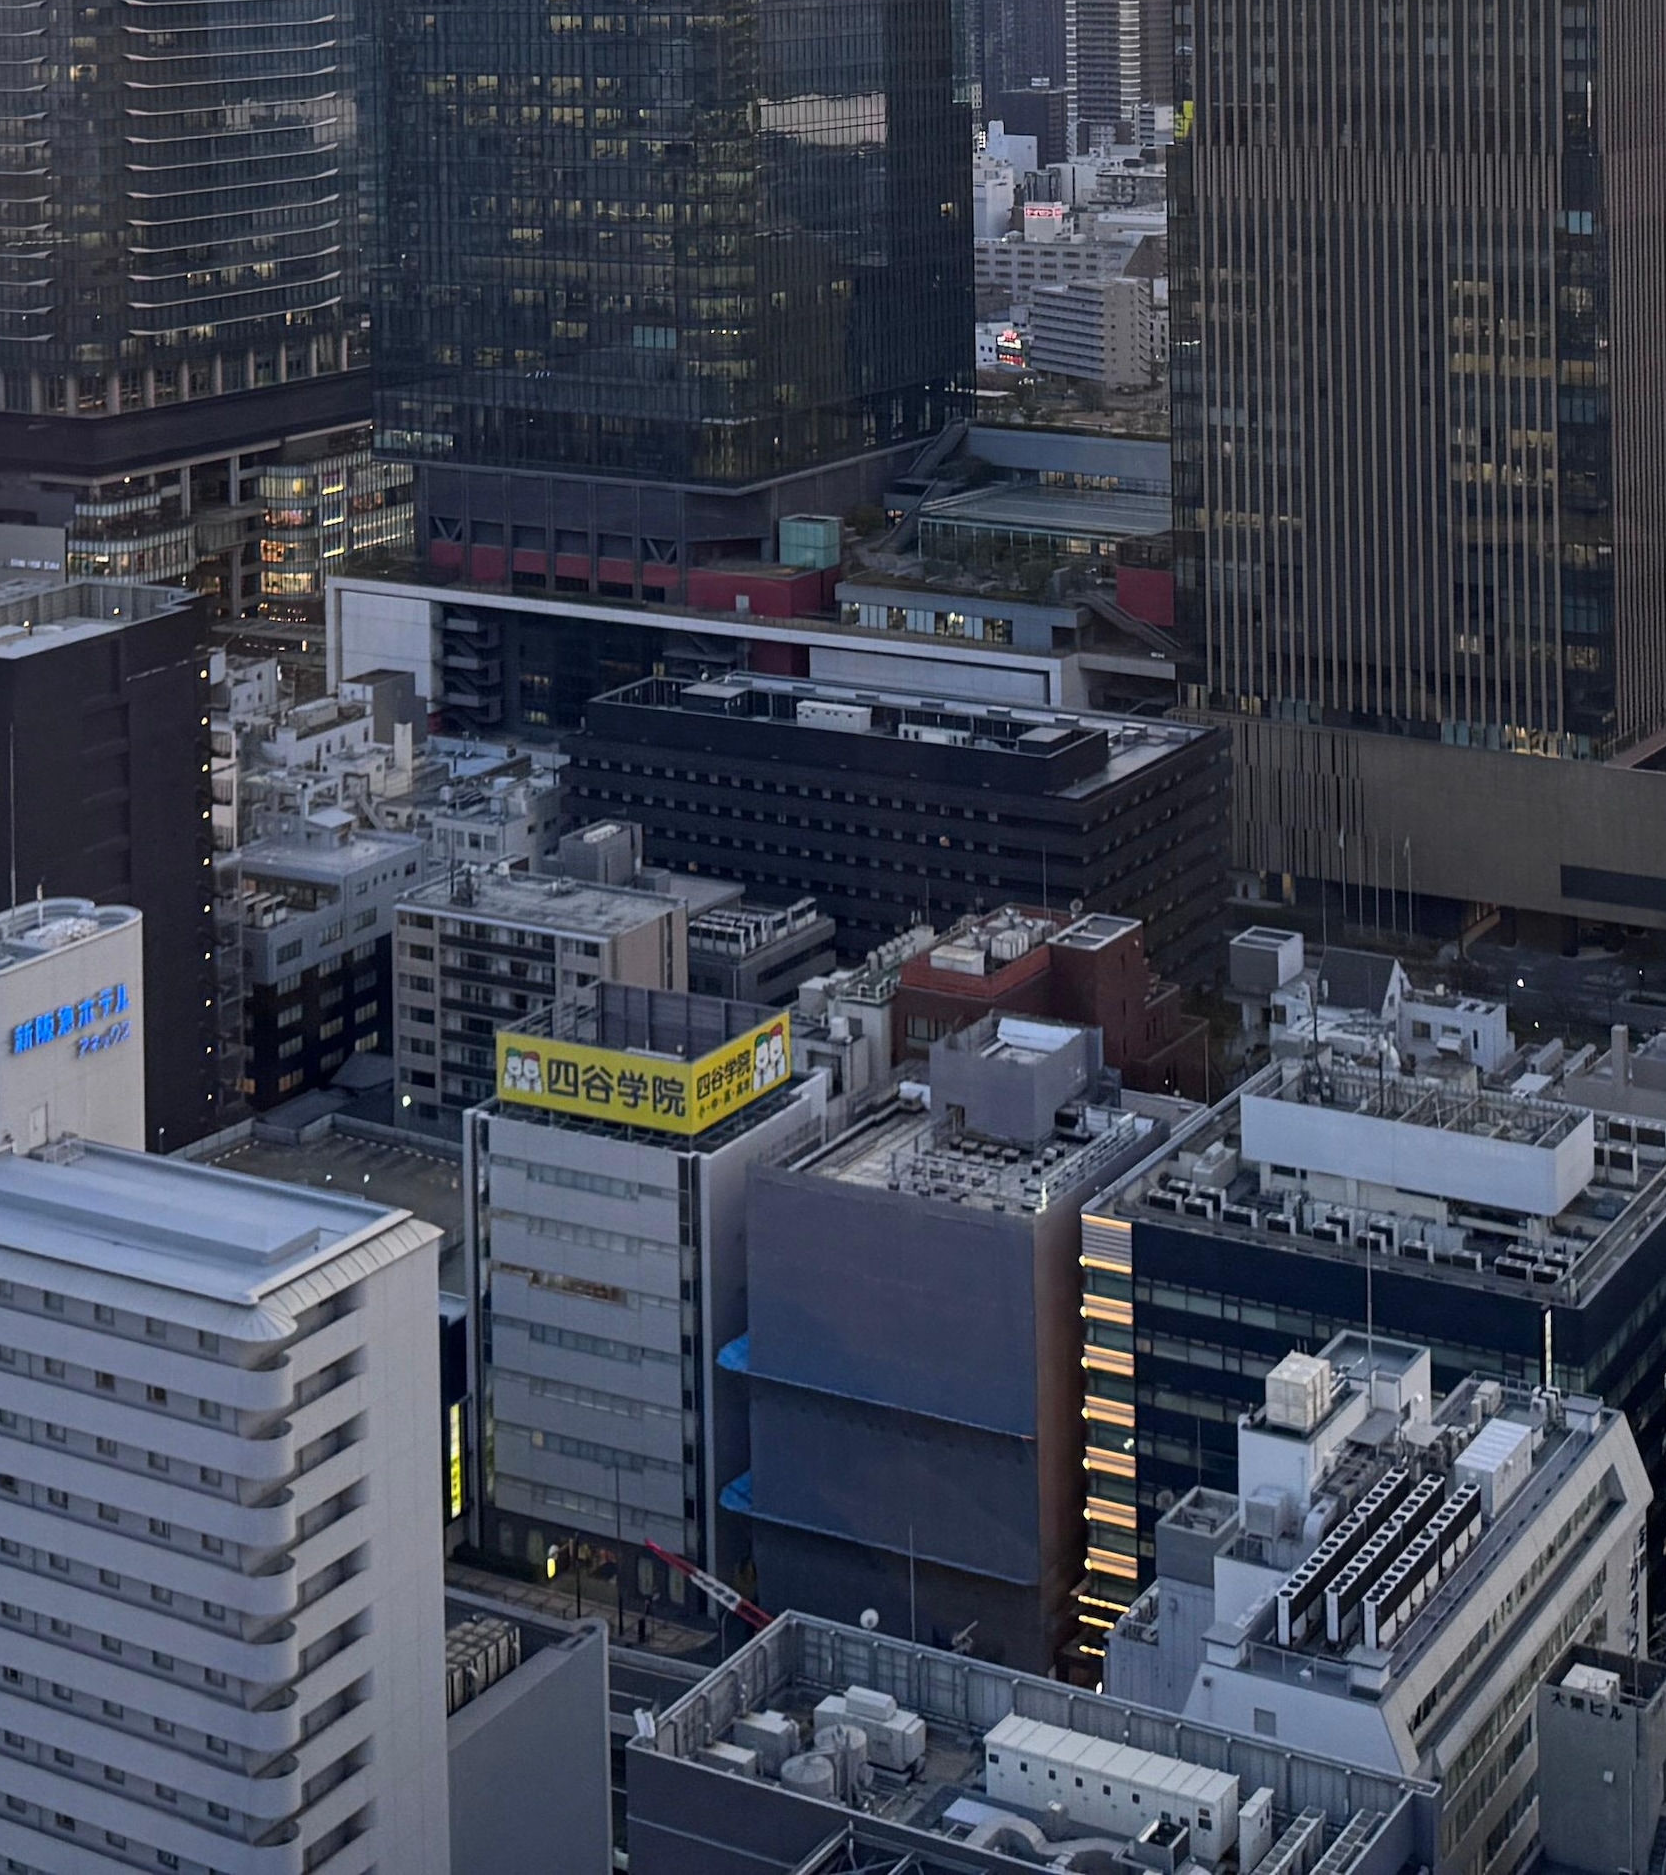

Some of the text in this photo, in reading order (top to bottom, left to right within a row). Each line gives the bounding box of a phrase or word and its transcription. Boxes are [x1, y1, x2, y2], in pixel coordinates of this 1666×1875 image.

[13, 983, 131, 1055] 新阪急ホテル
[547, 1058, 687, 1118] 四谷学院
[697, 1049, 752, 1101] 四谷学院
